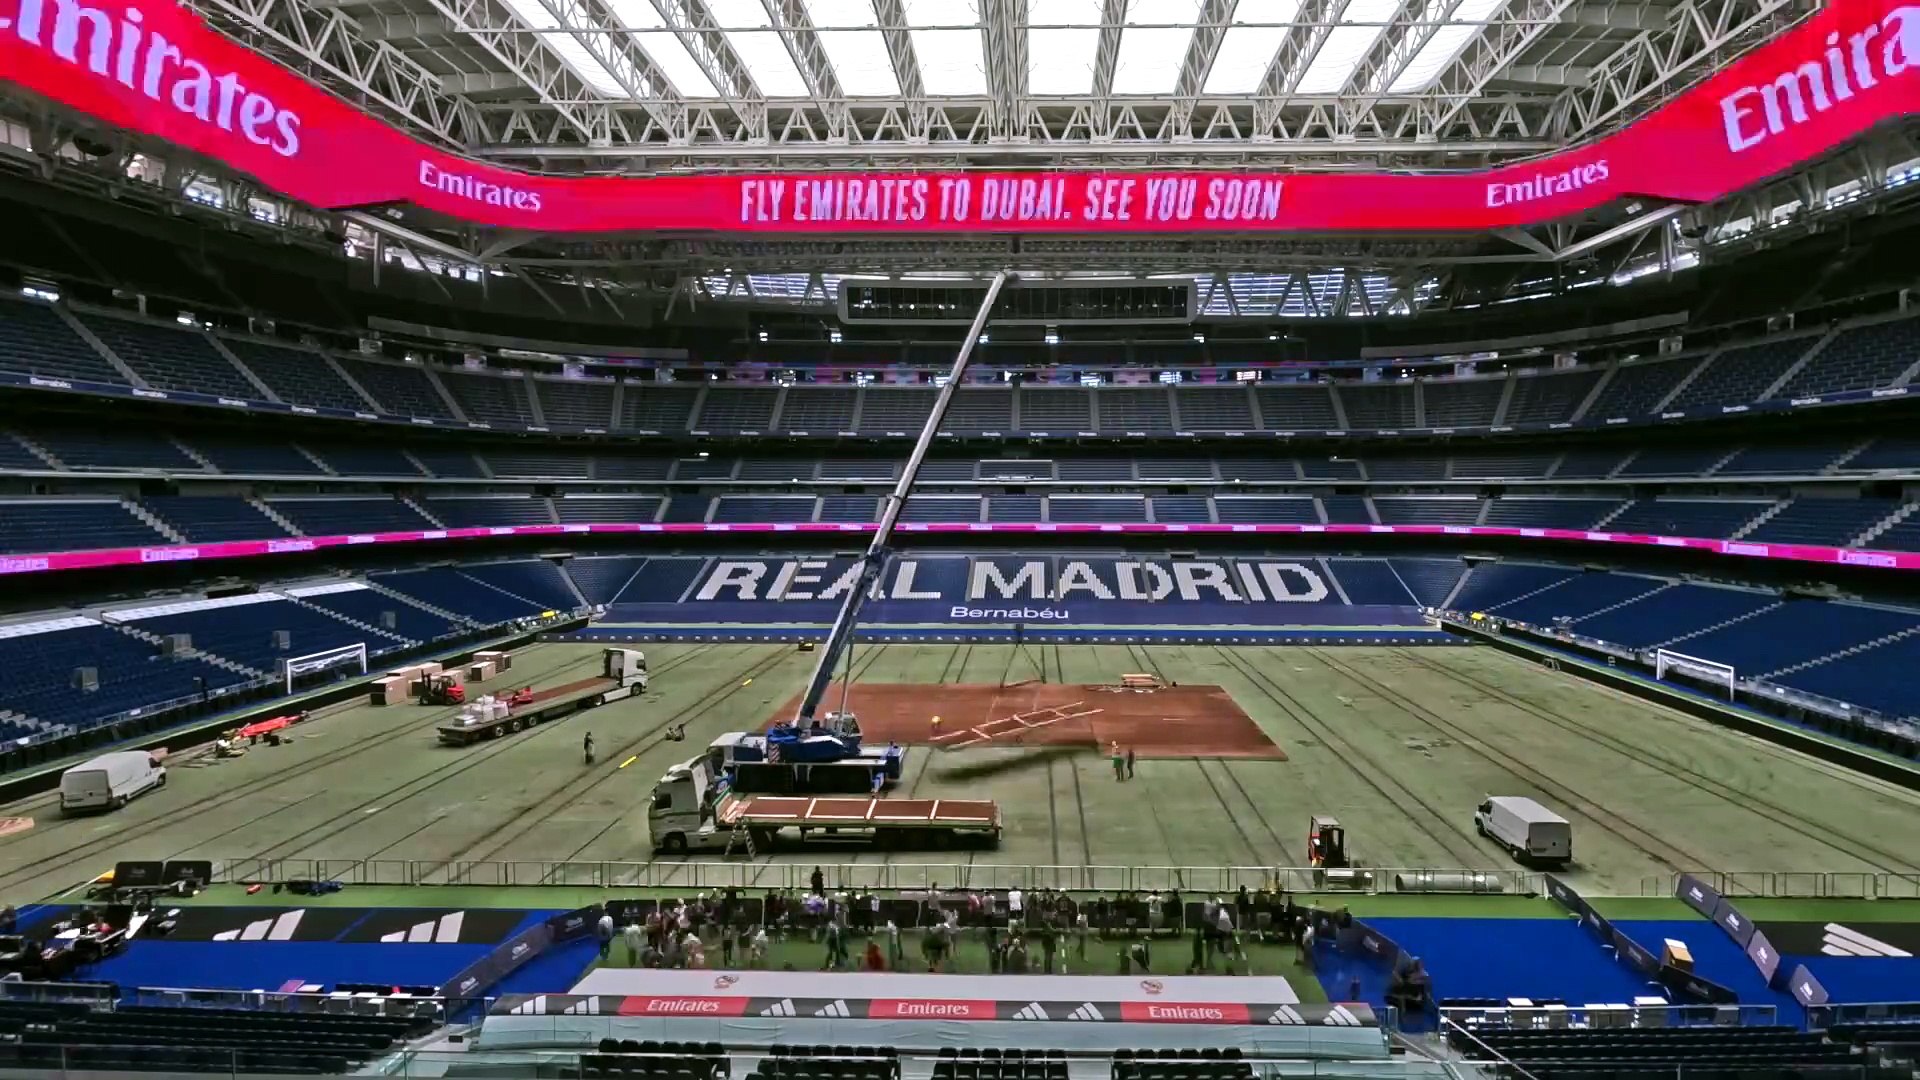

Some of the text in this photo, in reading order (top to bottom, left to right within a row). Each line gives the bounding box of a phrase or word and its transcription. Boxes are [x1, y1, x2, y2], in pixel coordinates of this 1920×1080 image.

[0, 0, 300, 157] mirates
[419, 160, 541, 212] Emirates
[741, 179, 1284, 222] FLY EMIRATES TO DUBAI. SEE YOU SOON
[1487, 159, 1609, 208] Emirates
[696, 561, 1329, 602] REAL MADRID
[951, 605, 1069, 620] Bernabéu
[646, 999, 720, 1014] Emirates
[896, 1001, 970, 1017] Emirates
[1148, 1004, 1224, 1021] Emirates
